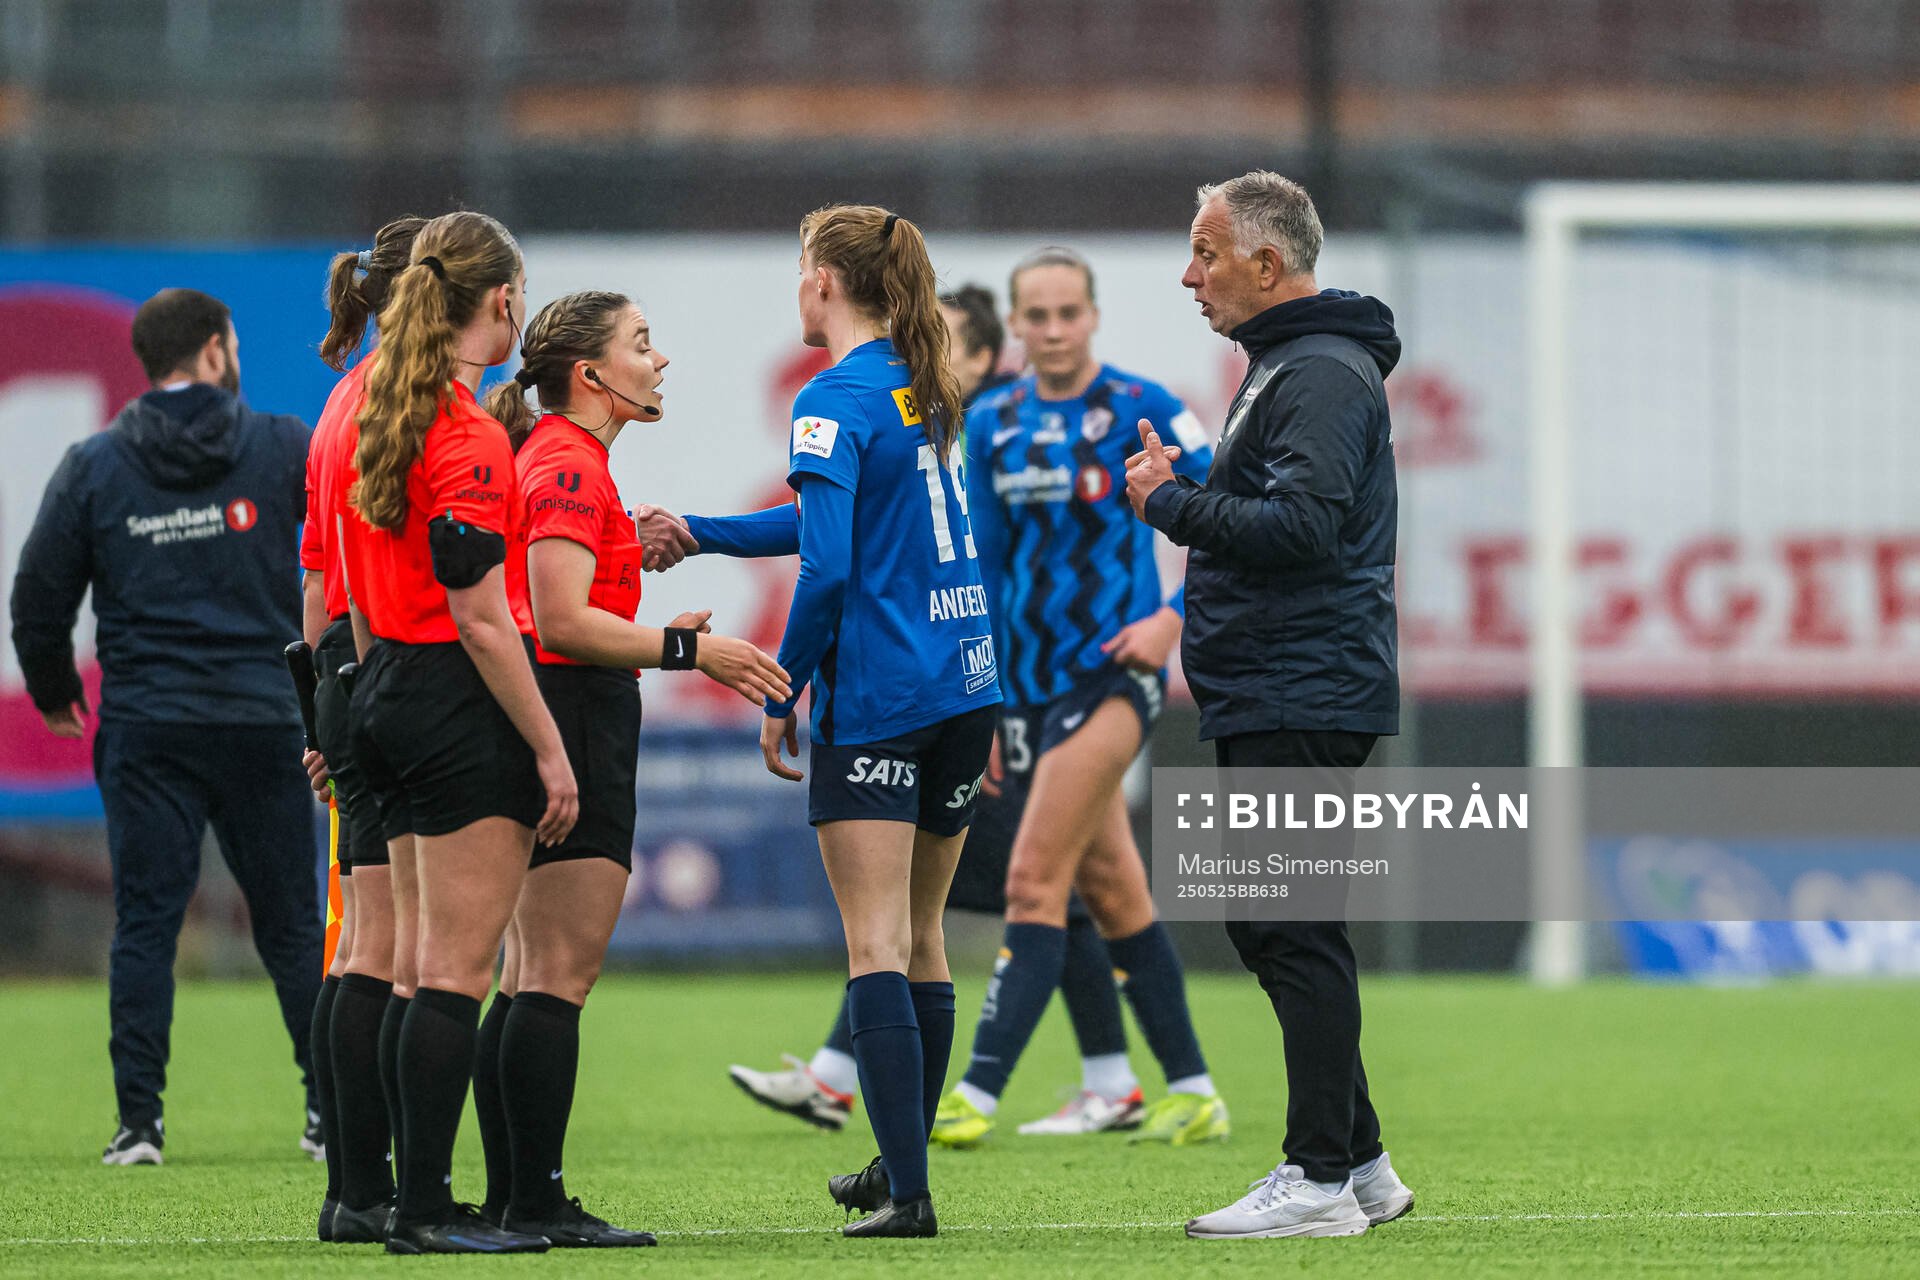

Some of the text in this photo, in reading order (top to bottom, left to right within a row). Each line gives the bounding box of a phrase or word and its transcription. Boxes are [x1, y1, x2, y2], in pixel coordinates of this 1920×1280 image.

[803, 441, 828, 454] Tipping
[535, 495, 596, 520] unisport
[917, 440, 977, 563] 19
[126, 503, 223, 537] SpareBank
[846, 756, 917, 788] SATS
